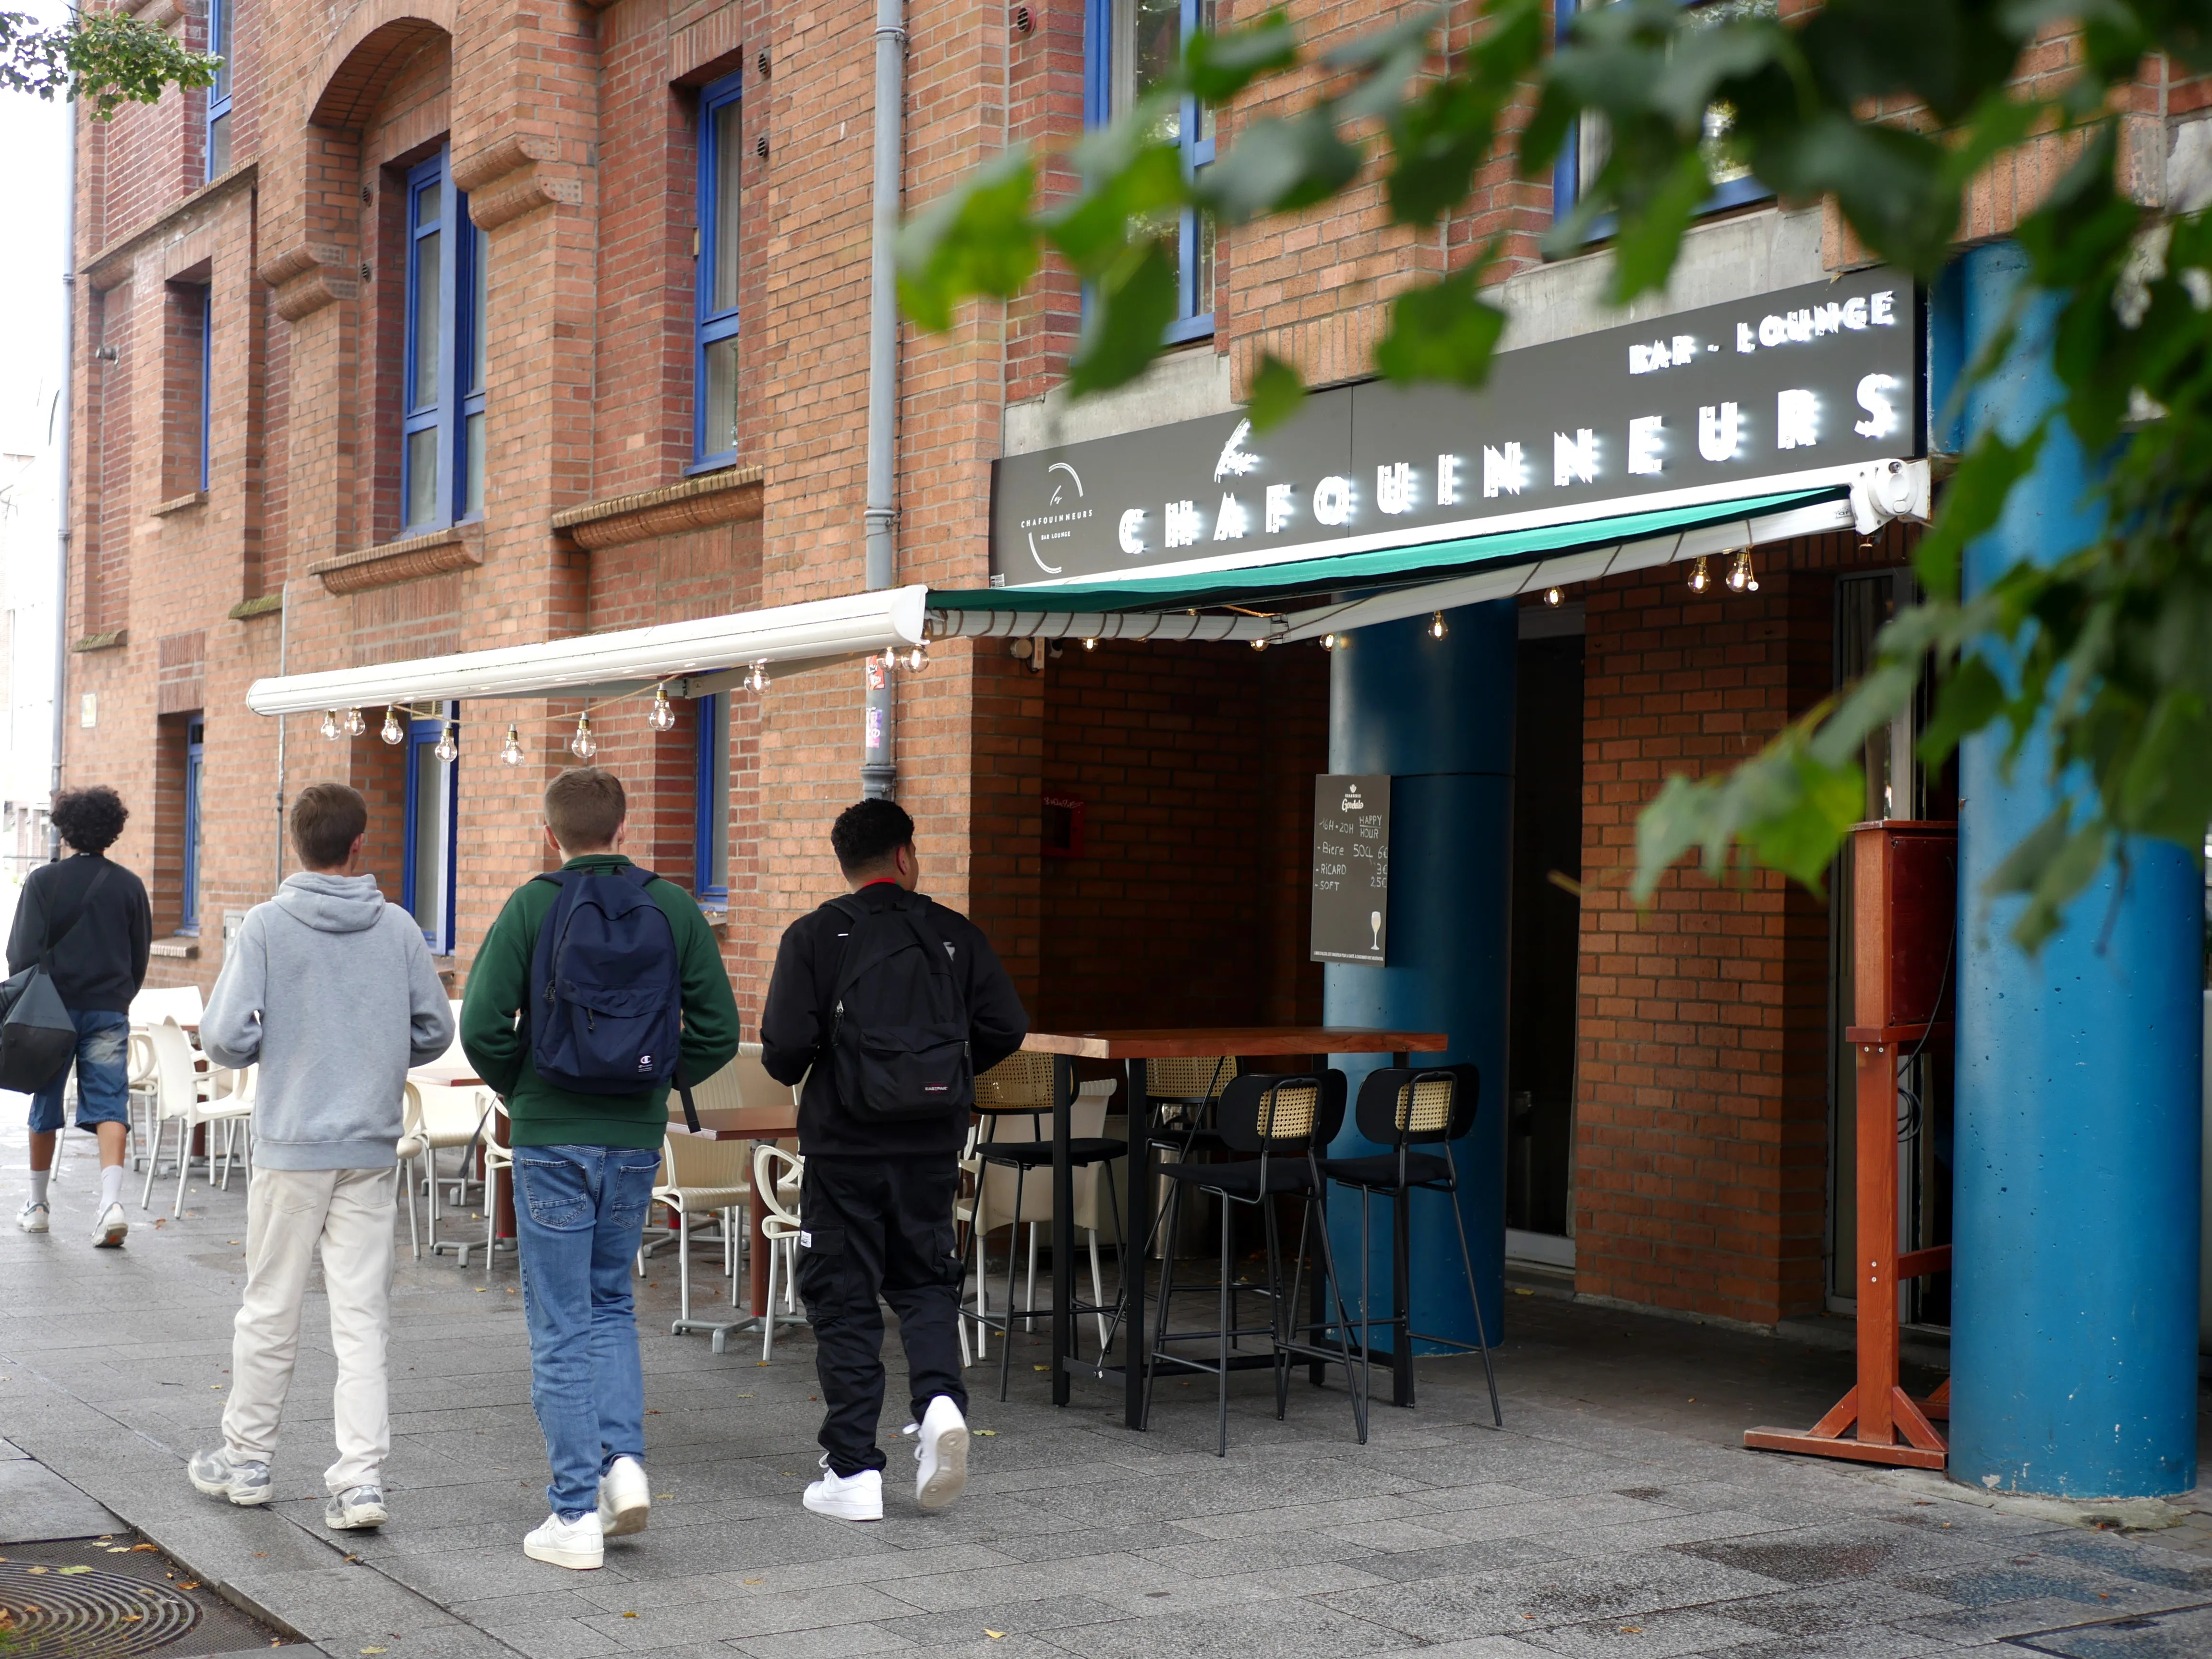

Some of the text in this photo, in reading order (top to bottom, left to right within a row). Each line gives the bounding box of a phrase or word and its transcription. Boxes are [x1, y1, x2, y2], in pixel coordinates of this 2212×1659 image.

[1629, 336, 1694, 374] BAR
[1736, 290, 1895, 353] LOUNGE
[1118, 373, 1896, 554] CHAFOUINNEURS
[1021, 509, 1093, 528] CHAFOUINNEURS
[1051, 531, 1070, 539] LOUNGE
[1359, 815, 1382, 826] HAPPY
[1360, 828, 1379, 839] HOUR
[1320, 880, 1340, 891] SOFT
